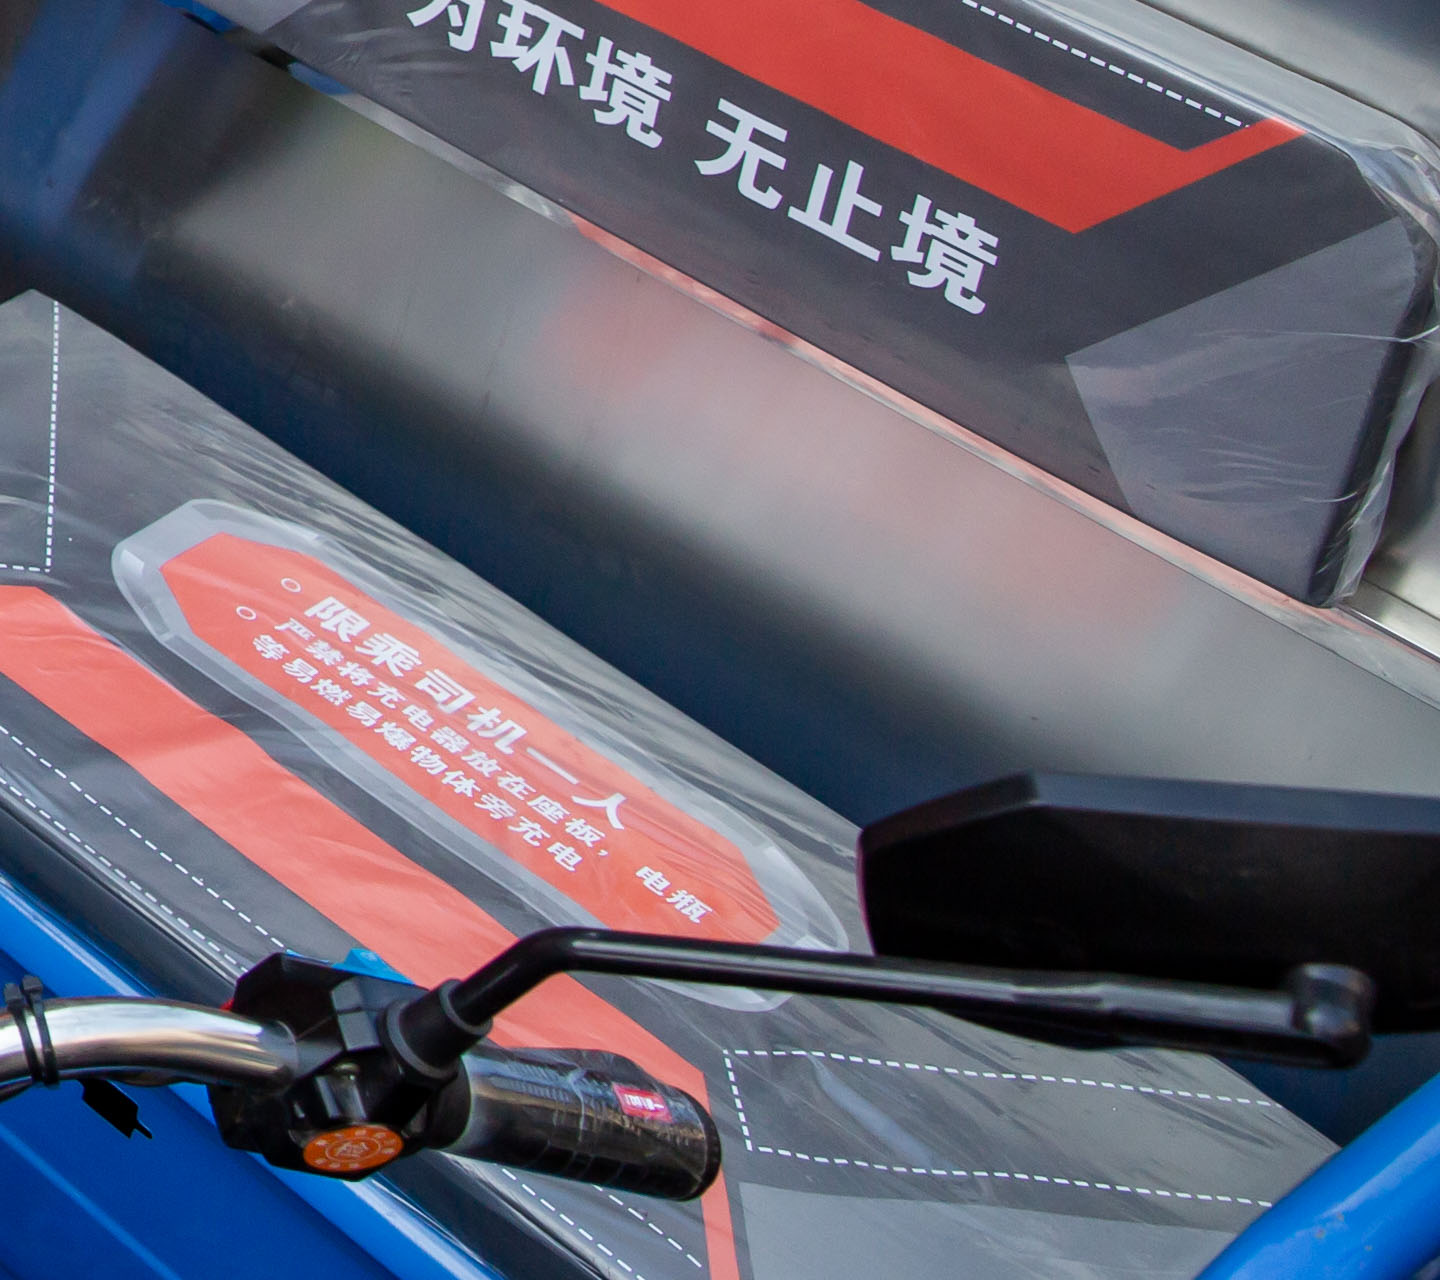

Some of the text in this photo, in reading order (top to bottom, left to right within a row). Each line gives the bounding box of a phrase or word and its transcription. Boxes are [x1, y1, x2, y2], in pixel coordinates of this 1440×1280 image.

[694, 97, 1000, 317] 无止境
[252, 633, 585, 873] 等易燃易爆物体旁充电
[303, 595, 625, 831] 限乘司机一人
[635, 864, 716, 925] 电瓶
